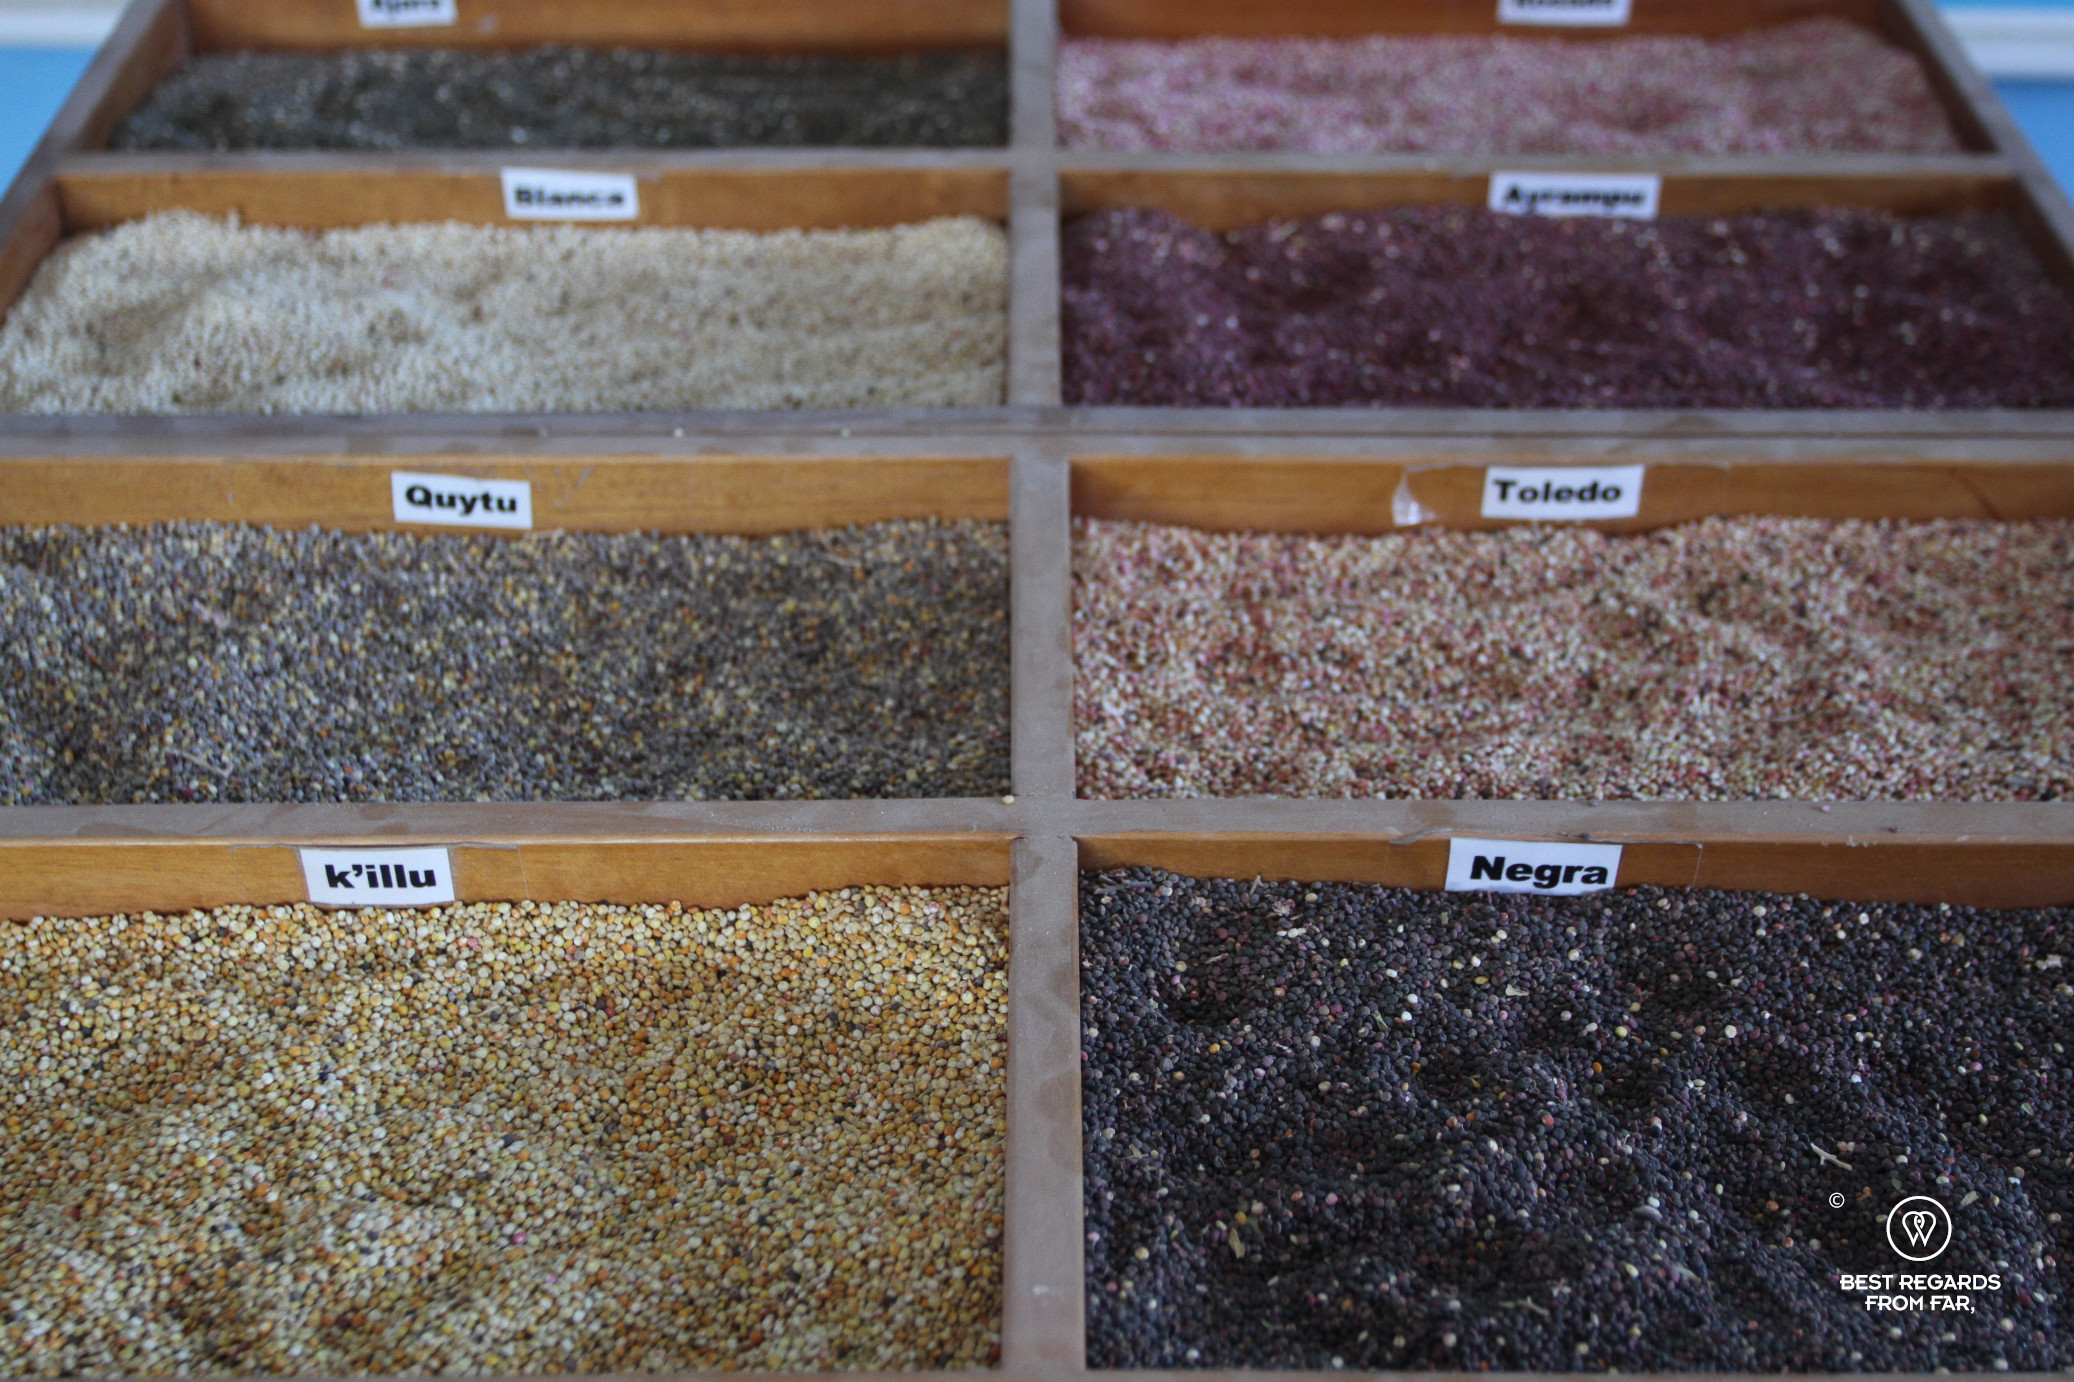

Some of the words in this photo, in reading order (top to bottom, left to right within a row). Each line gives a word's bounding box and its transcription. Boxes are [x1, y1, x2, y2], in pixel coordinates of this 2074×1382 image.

[406, 485, 517, 515] Quytu
[1496, 480, 1622, 502] Toledo
[325, 864, 437, 889] k’illu
[1470, 855, 1609, 889] Negra
